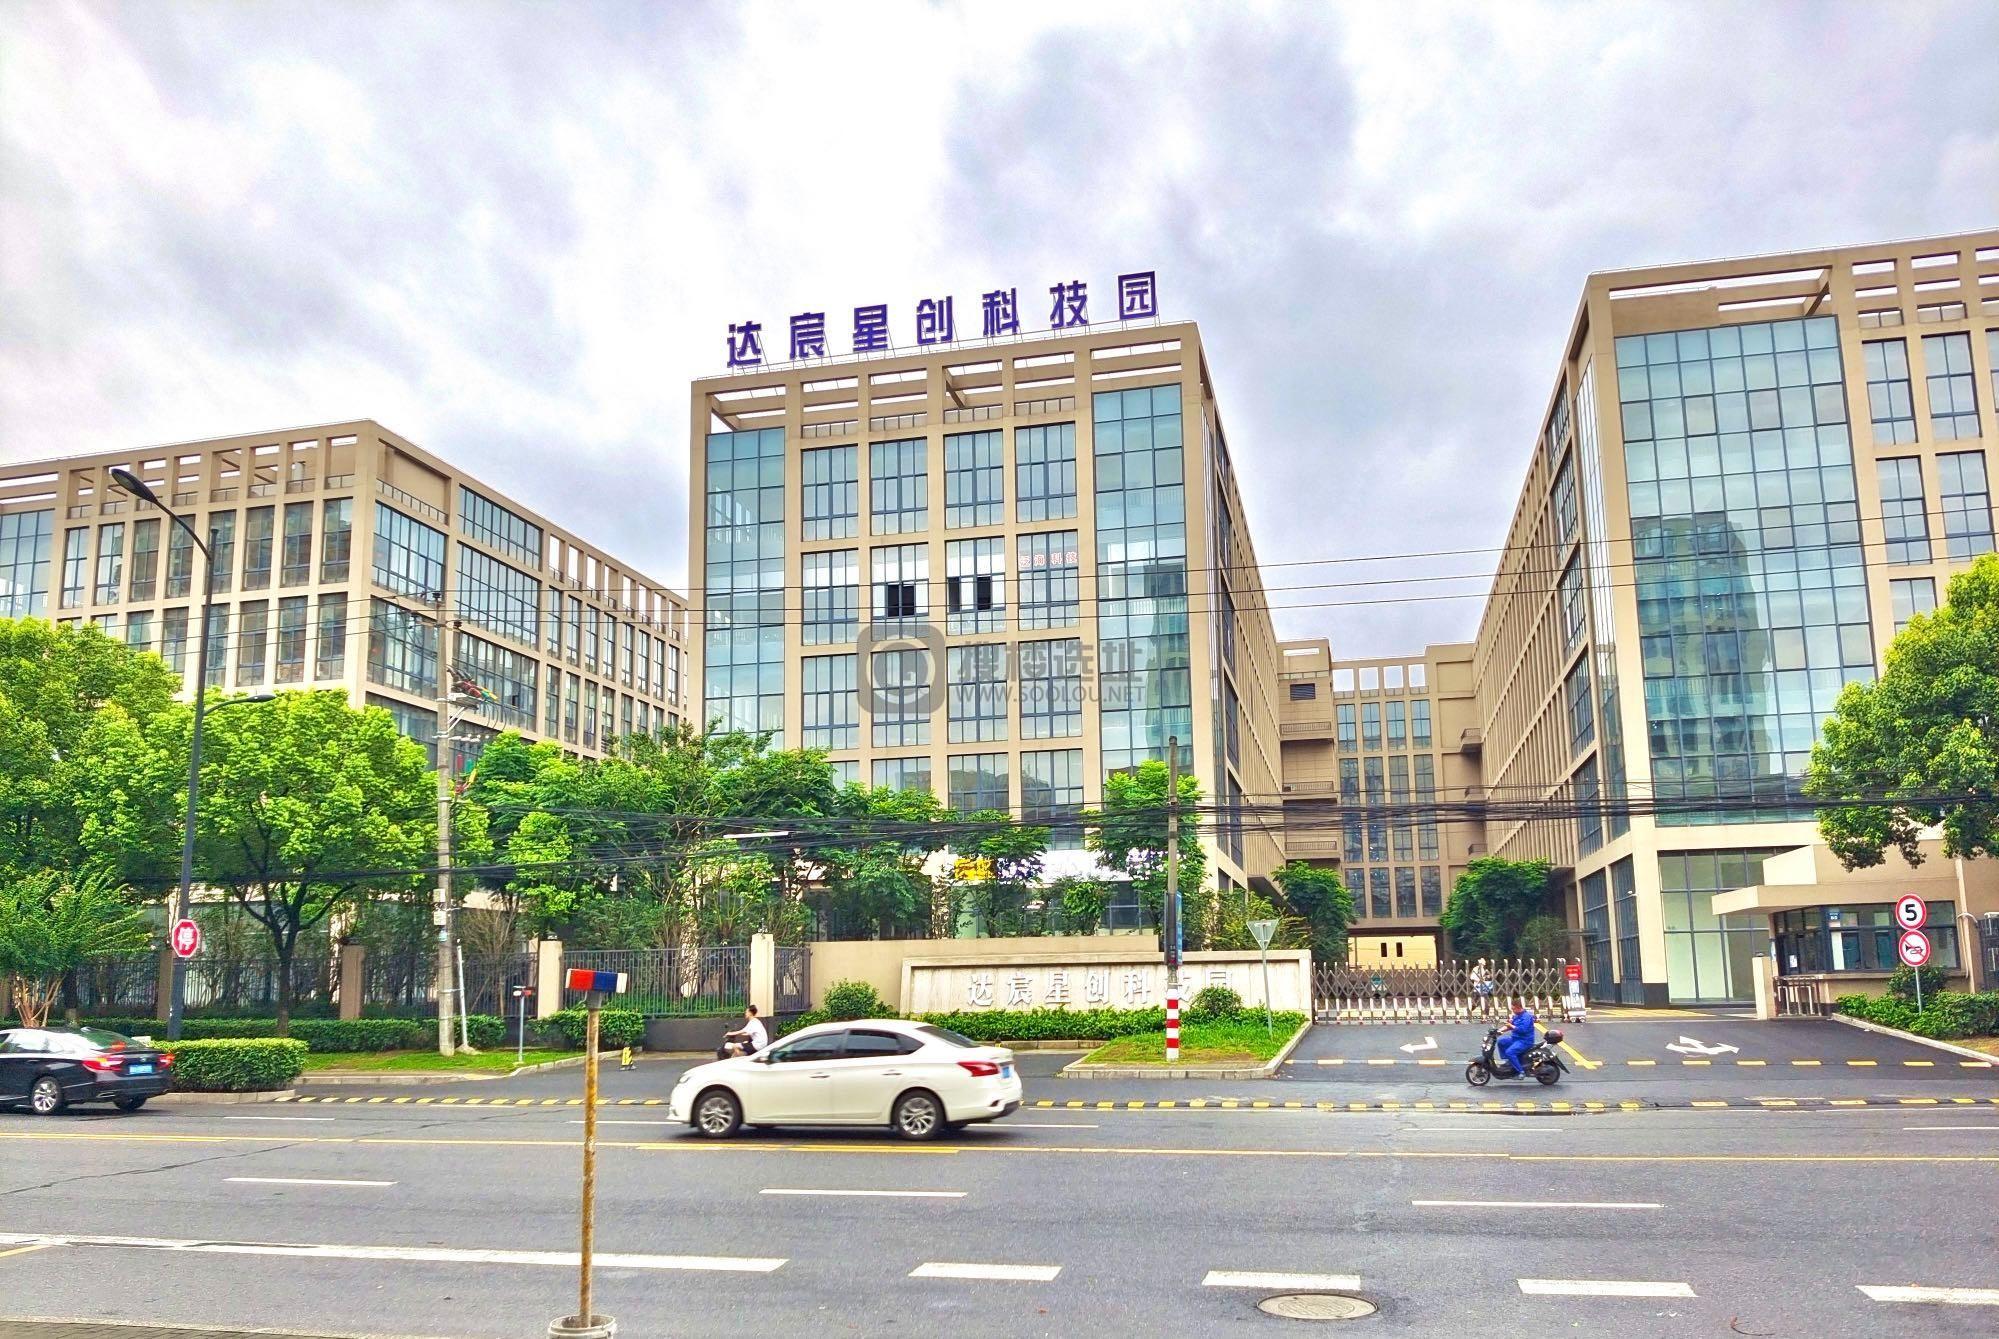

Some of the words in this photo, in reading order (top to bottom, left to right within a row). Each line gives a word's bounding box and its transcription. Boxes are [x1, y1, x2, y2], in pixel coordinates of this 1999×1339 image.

[727, 271, 1156, 368] 达宸星创科技园
[1905, 904, 1917, 921] 5
